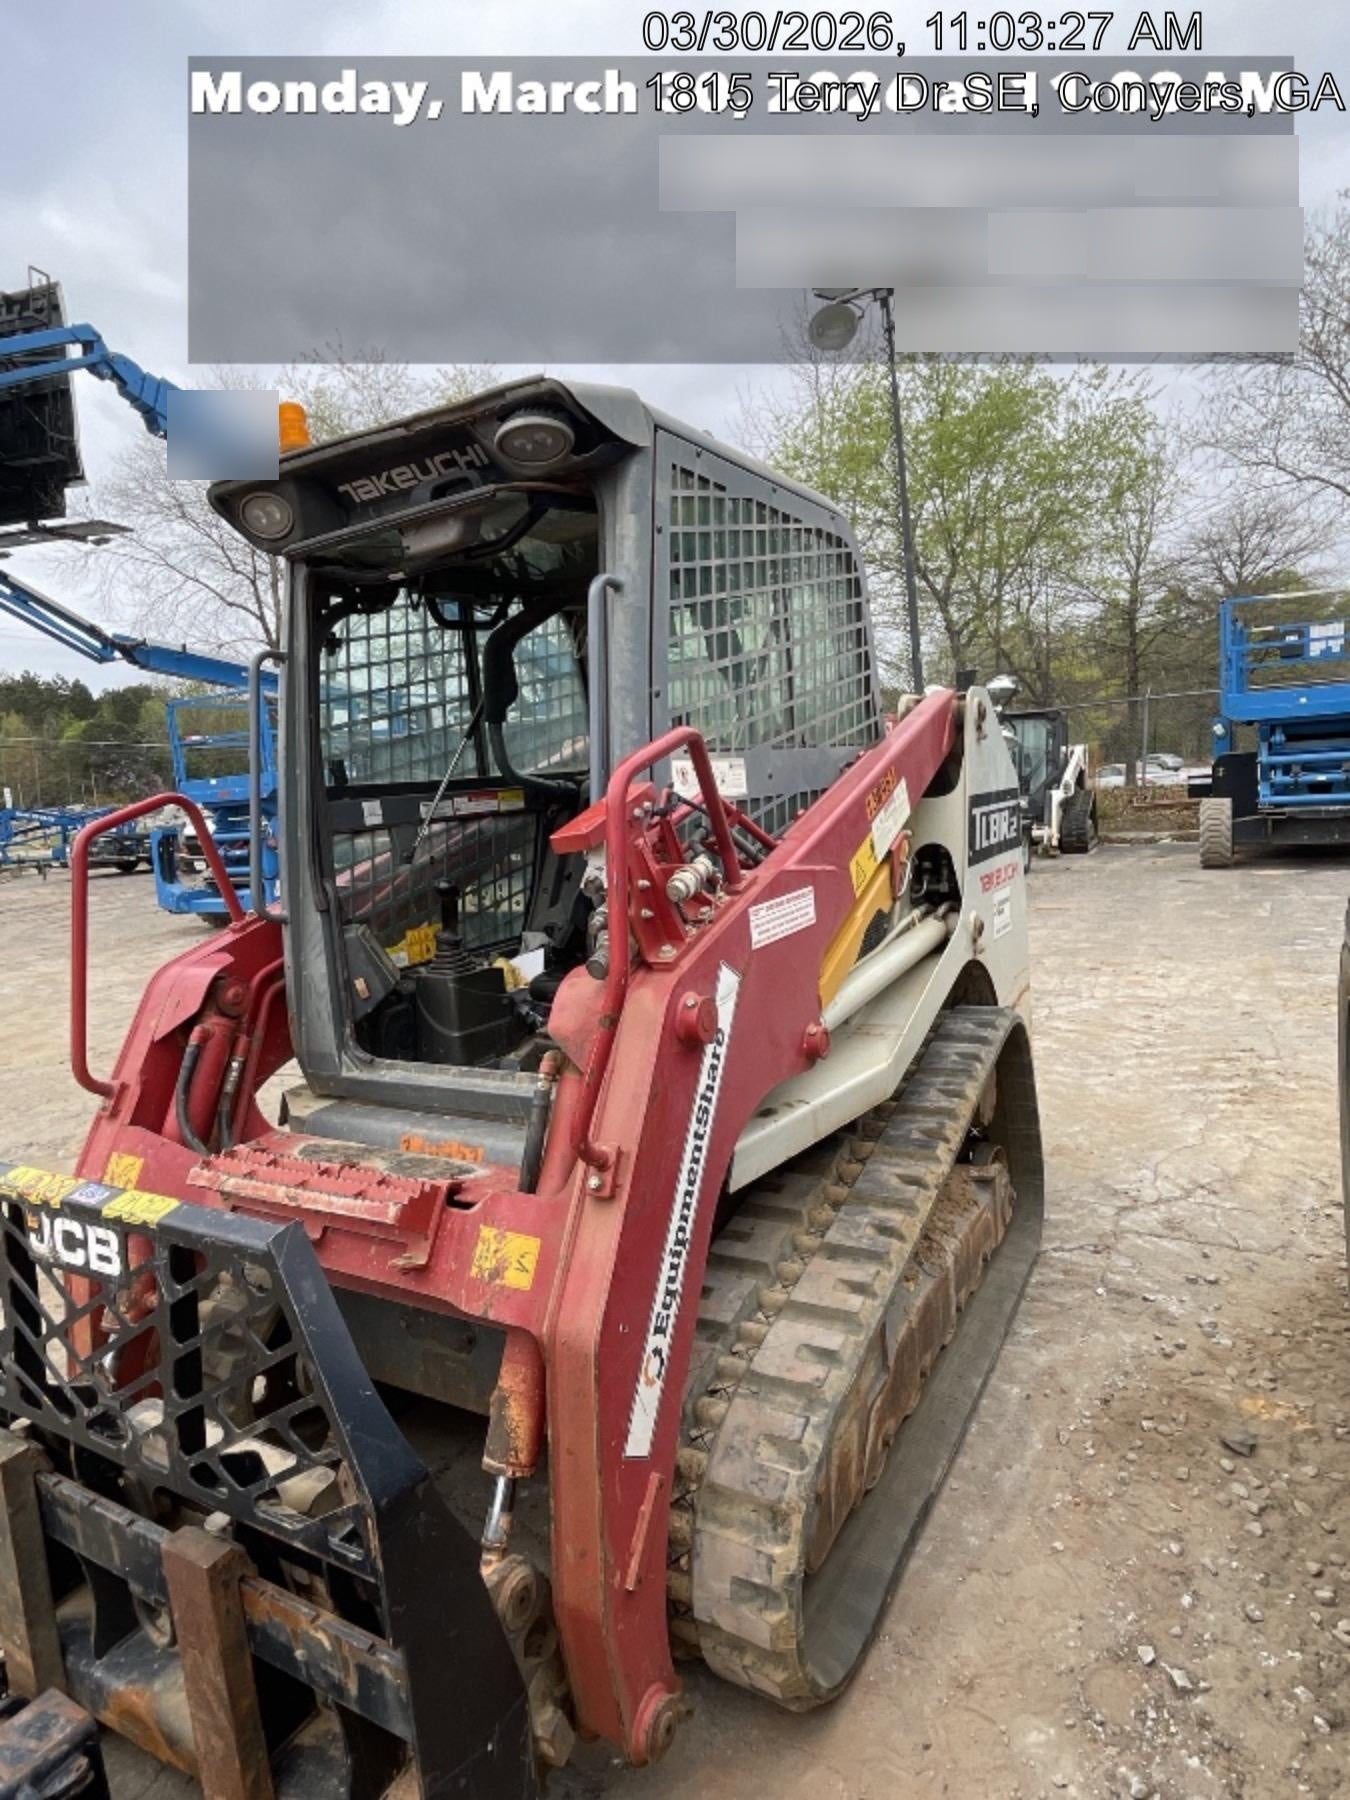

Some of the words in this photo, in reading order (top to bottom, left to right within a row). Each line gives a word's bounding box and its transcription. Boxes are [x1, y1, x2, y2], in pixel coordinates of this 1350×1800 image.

[337, 443, 490, 503] TAKEUCHI
[652, 1027, 726, 1339] EquipmentShare
[29, 1212, 121, 1276] JCB
